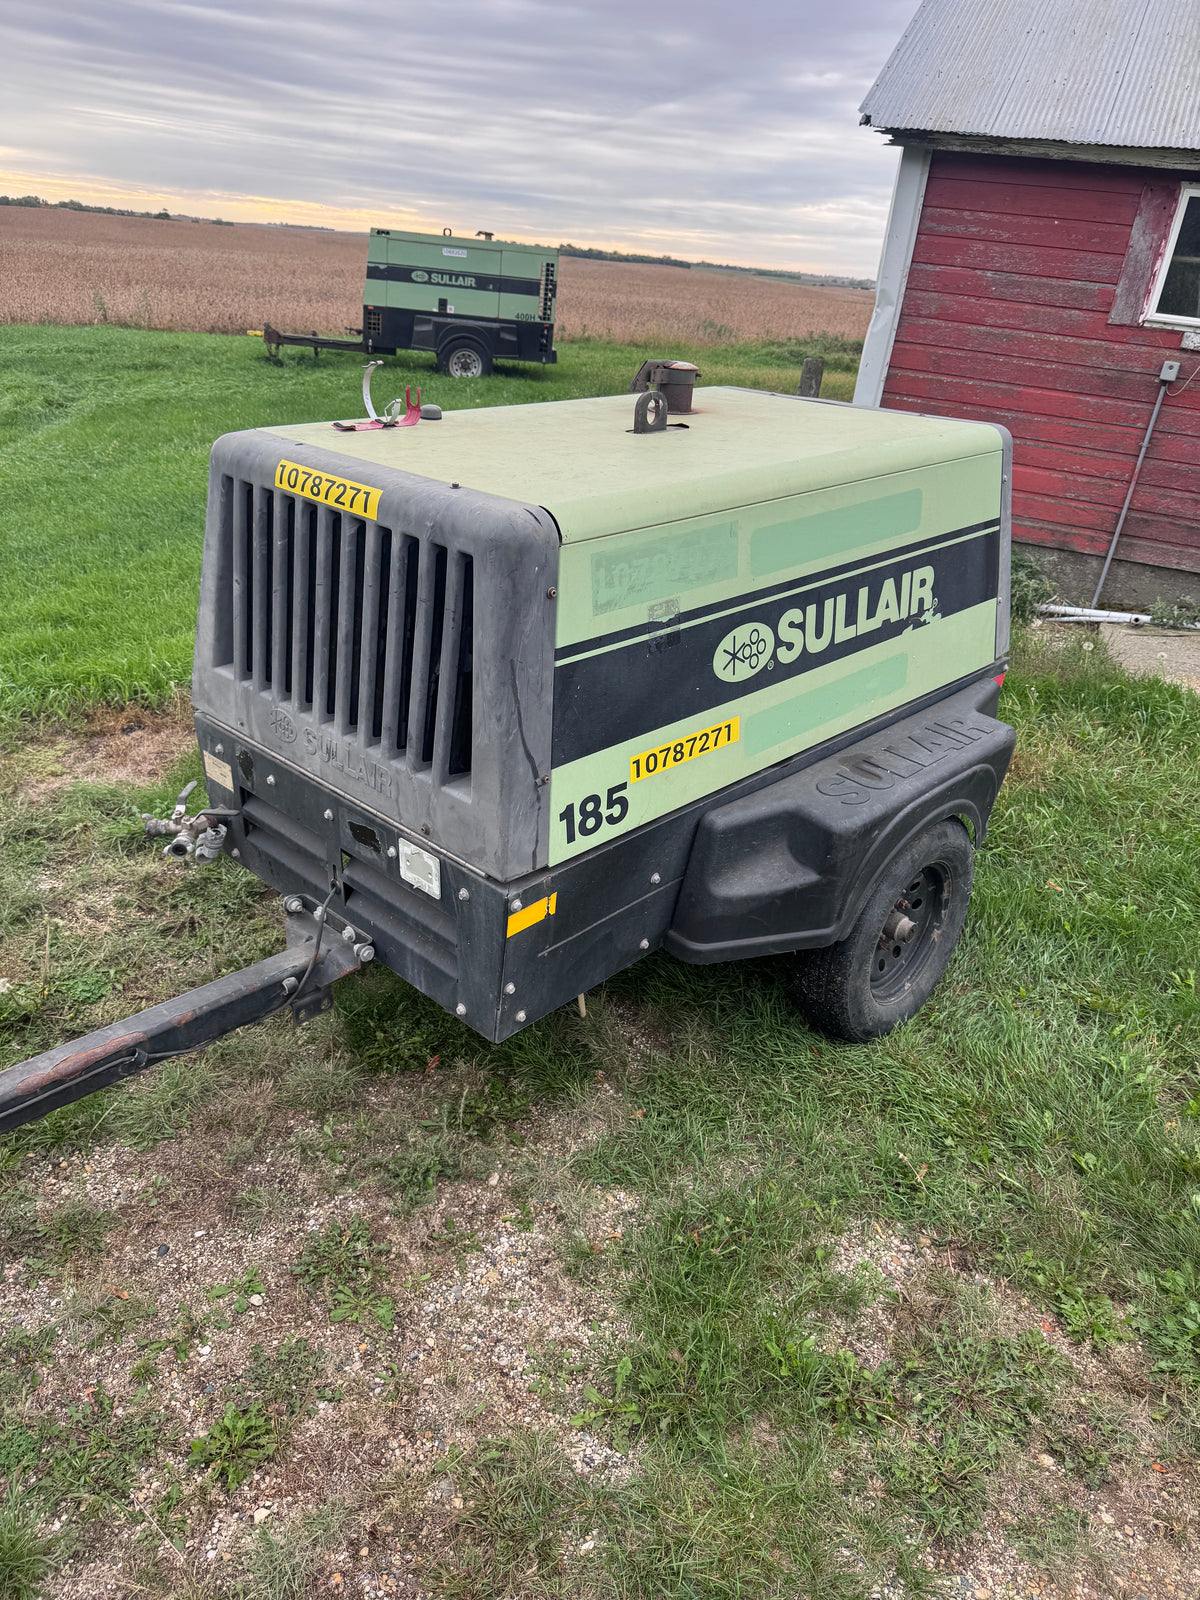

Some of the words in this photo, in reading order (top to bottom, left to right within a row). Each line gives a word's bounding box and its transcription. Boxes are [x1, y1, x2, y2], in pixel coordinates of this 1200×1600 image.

[430, 272, 477, 287] SULLAIR
[279, 464, 371, 513] 10787271
[776, 565, 935, 664] SULLAIR
[304, 727, 393, 799] SULLAIR
[632, 723, 732, 778] 10787271
[815, 719, 994, 805] SULLAIR
[559, 781, 629, 845] 185
